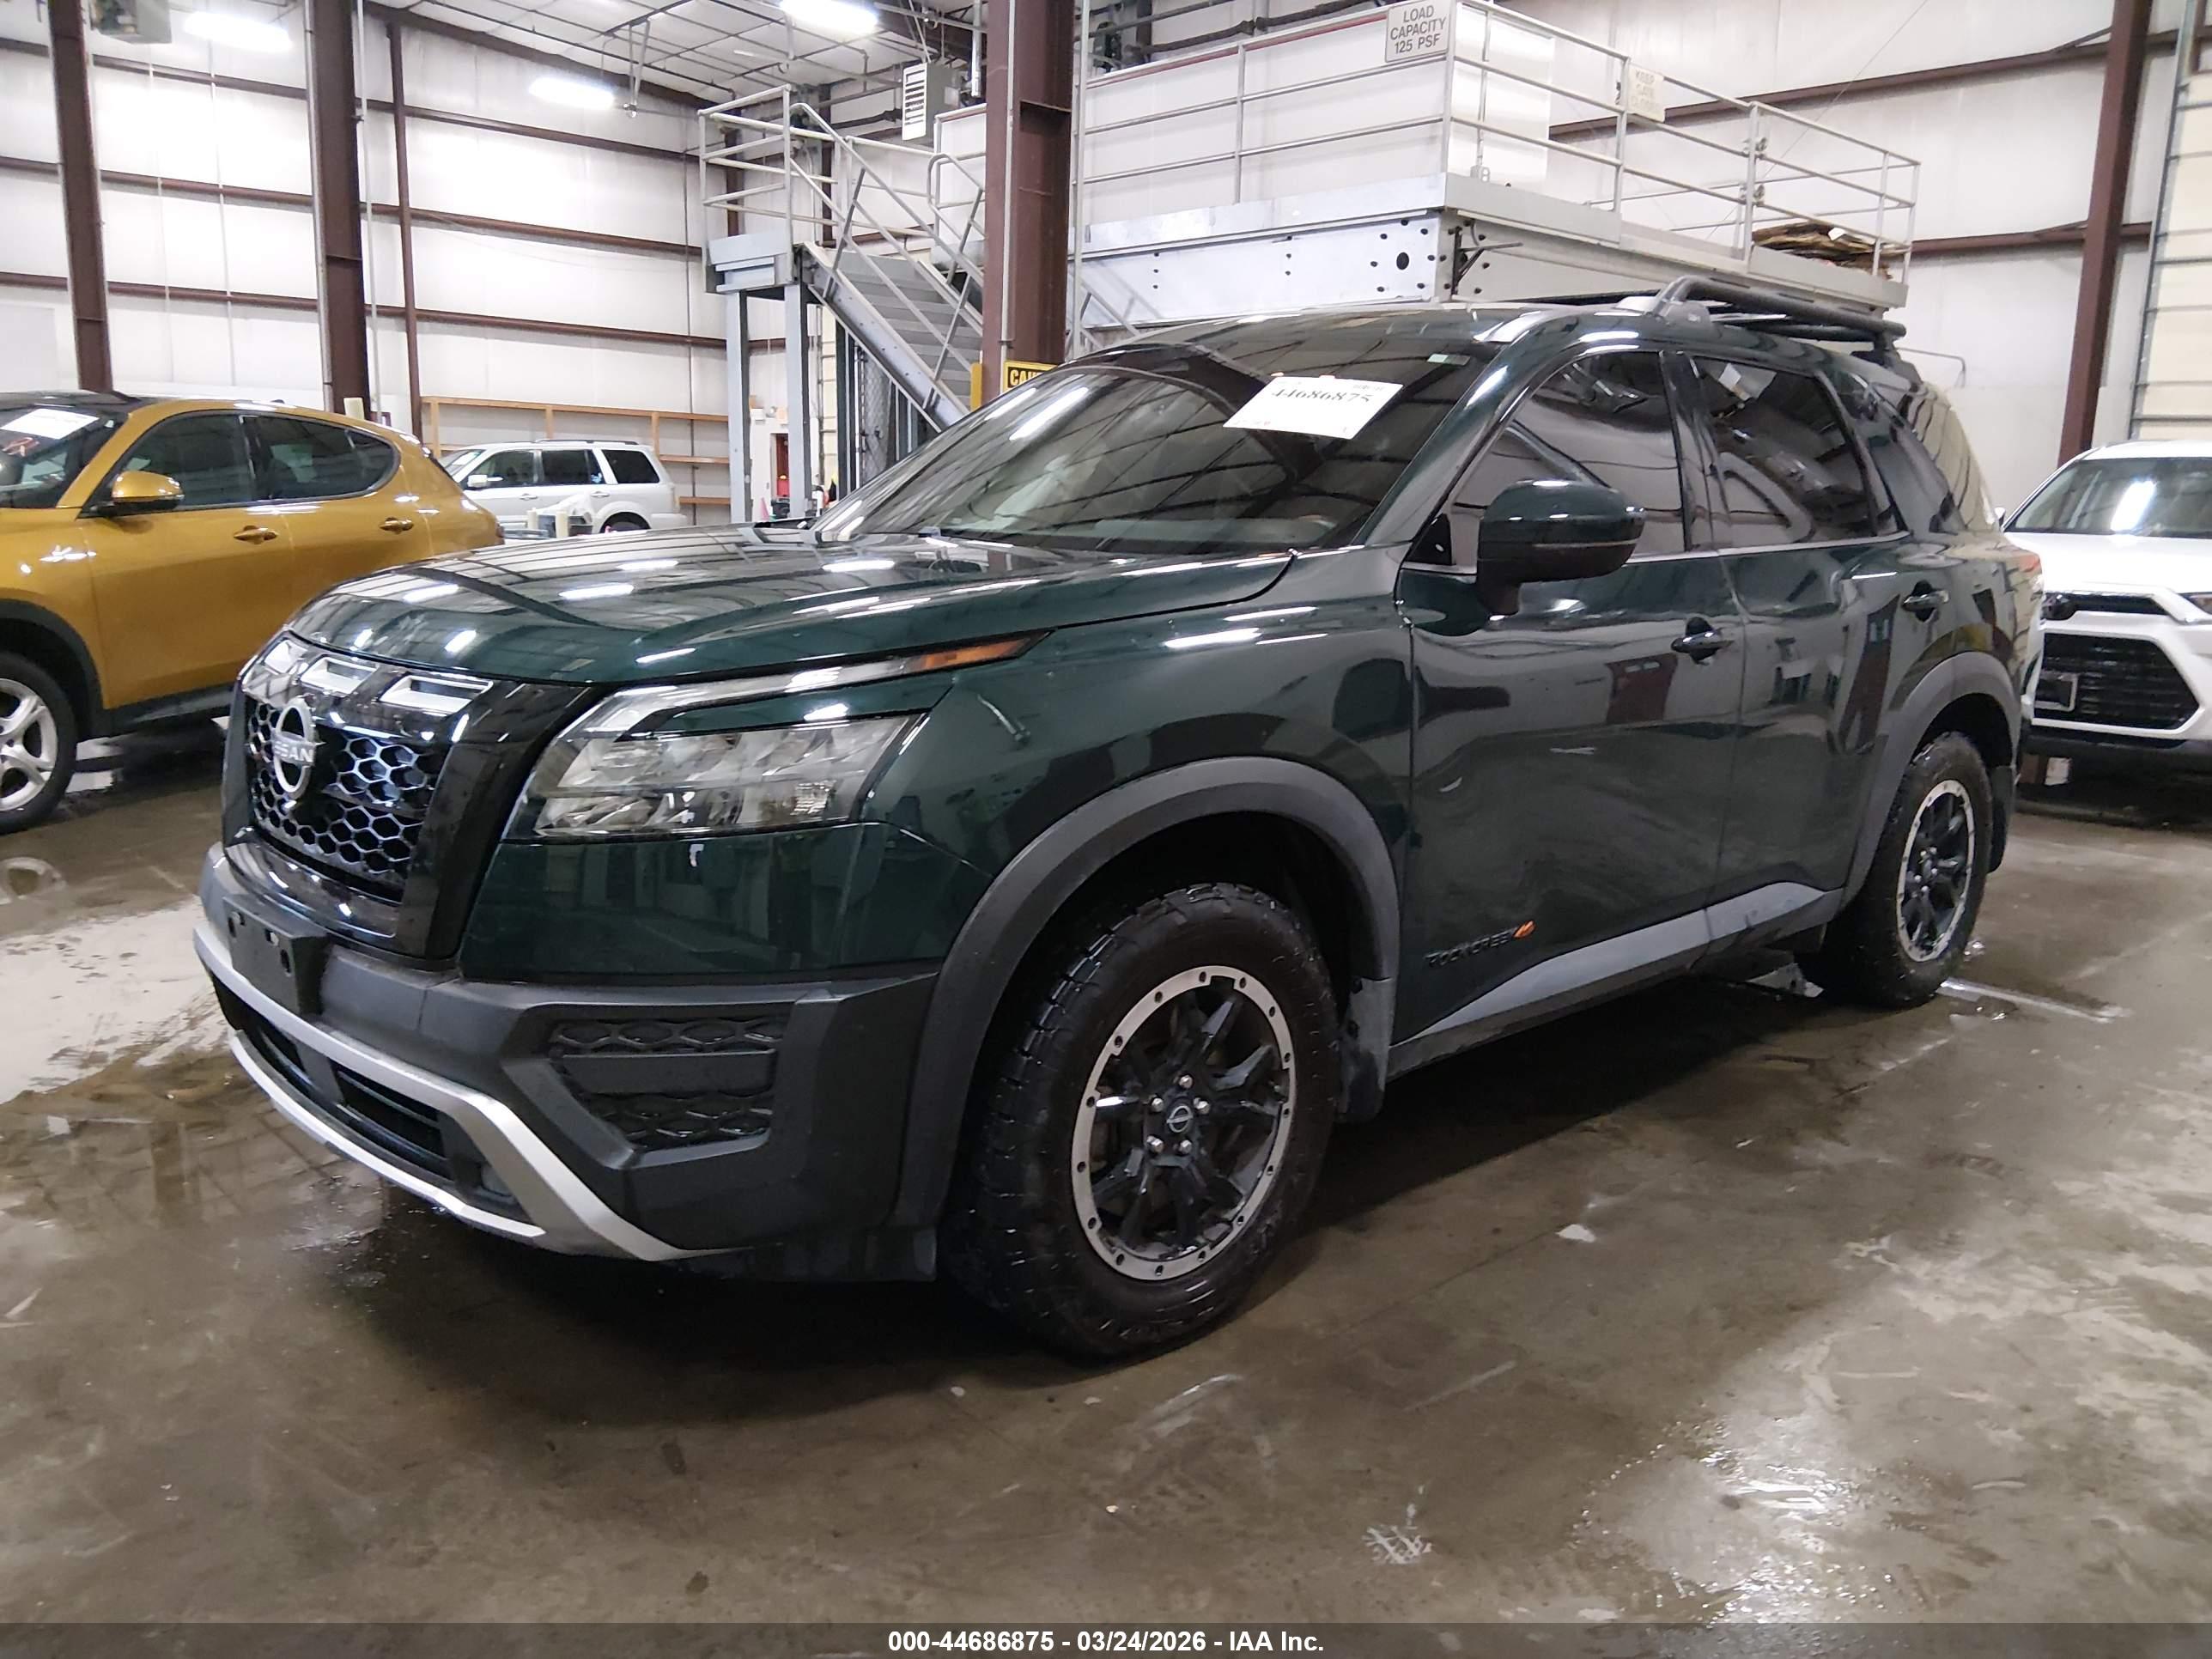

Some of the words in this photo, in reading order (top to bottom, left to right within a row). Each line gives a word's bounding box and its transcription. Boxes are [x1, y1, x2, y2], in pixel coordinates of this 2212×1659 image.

[1403, 5, 1435, 23] LOAD
[1390, 16, 1447, 40] CAPACITY
[1395, 39, 1413, 54] 125
[1418, 33, 1441, 50] PSF
